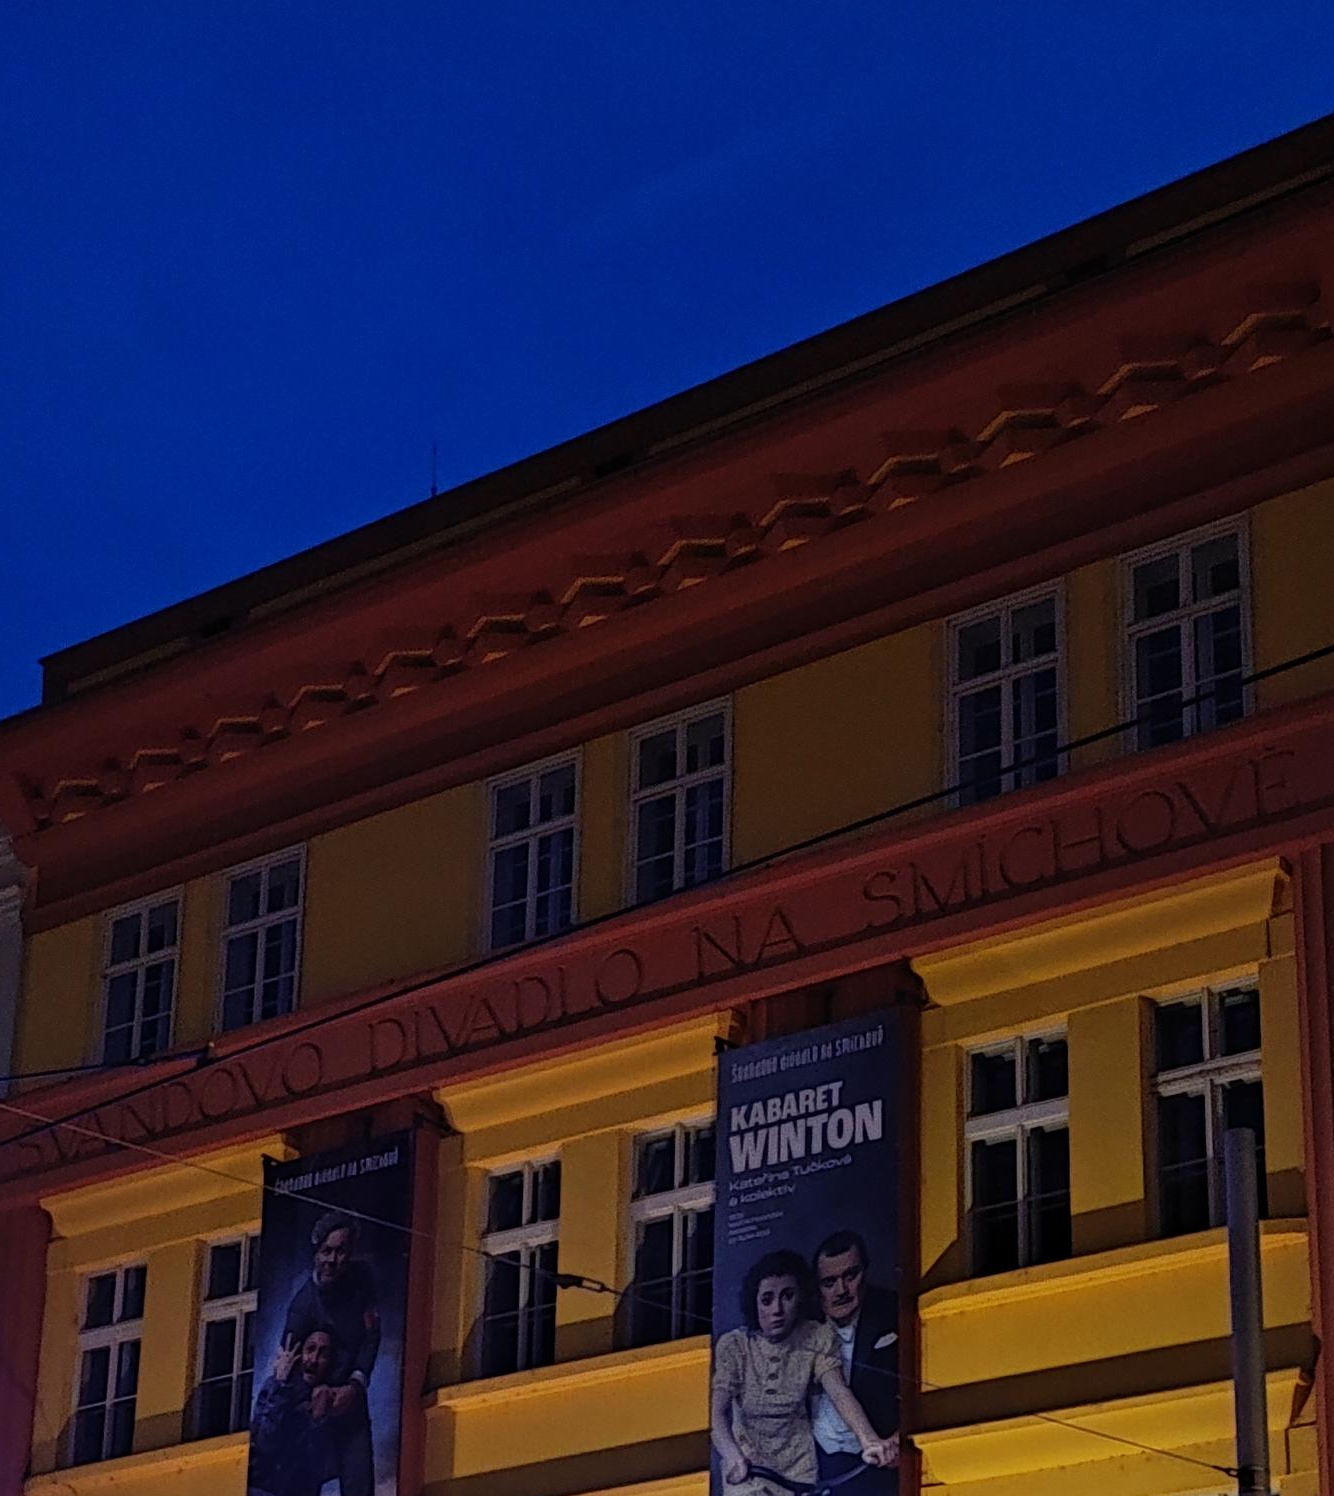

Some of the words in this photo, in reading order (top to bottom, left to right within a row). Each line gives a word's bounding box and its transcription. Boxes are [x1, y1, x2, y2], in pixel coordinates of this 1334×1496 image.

[367, 950, 643, 1073] DIVADLO
[691, 908, 806, 981] NA
[729, 1099, 883, 1174] WINTON
[730, 1080, 844, 1132] KABARET
